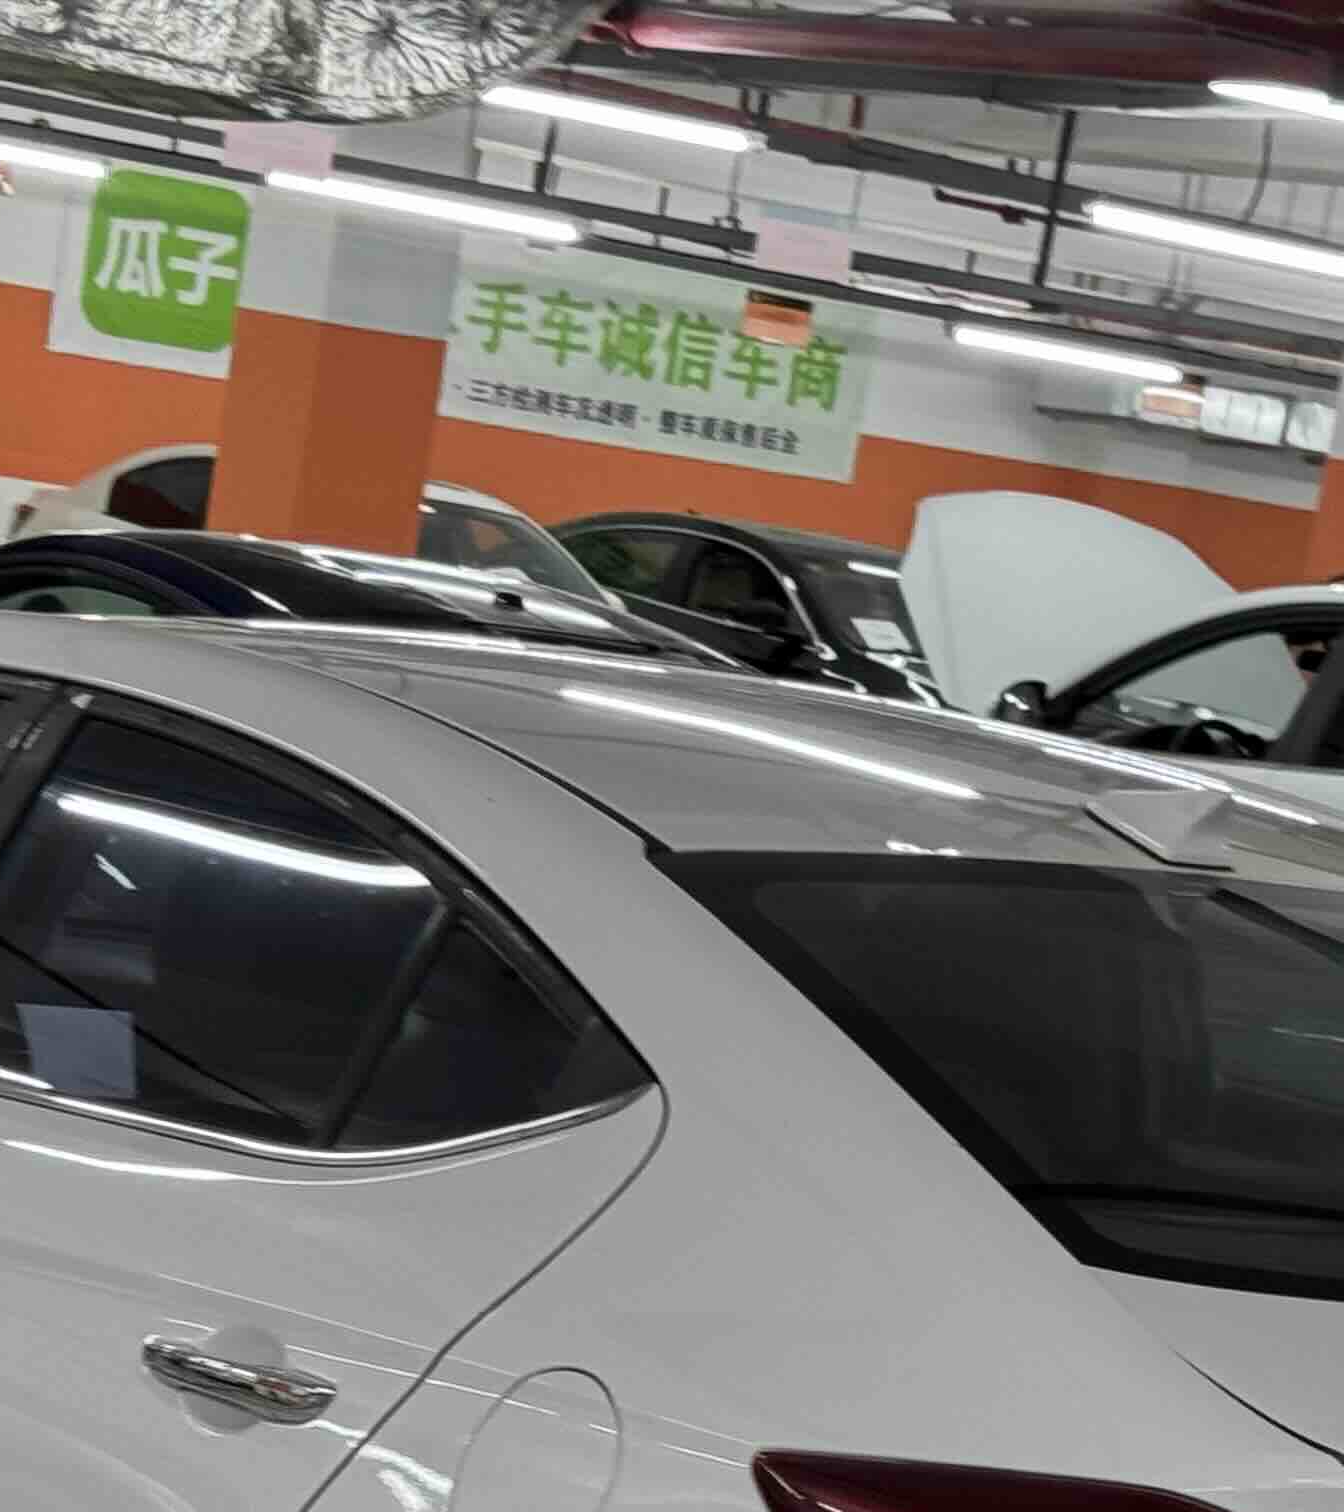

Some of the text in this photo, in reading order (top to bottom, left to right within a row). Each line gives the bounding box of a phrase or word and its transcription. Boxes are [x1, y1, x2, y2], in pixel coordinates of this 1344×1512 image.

[95, 216, 237, 306] 瓜子
[452, 281, 848, 411] 手车诚信车商
